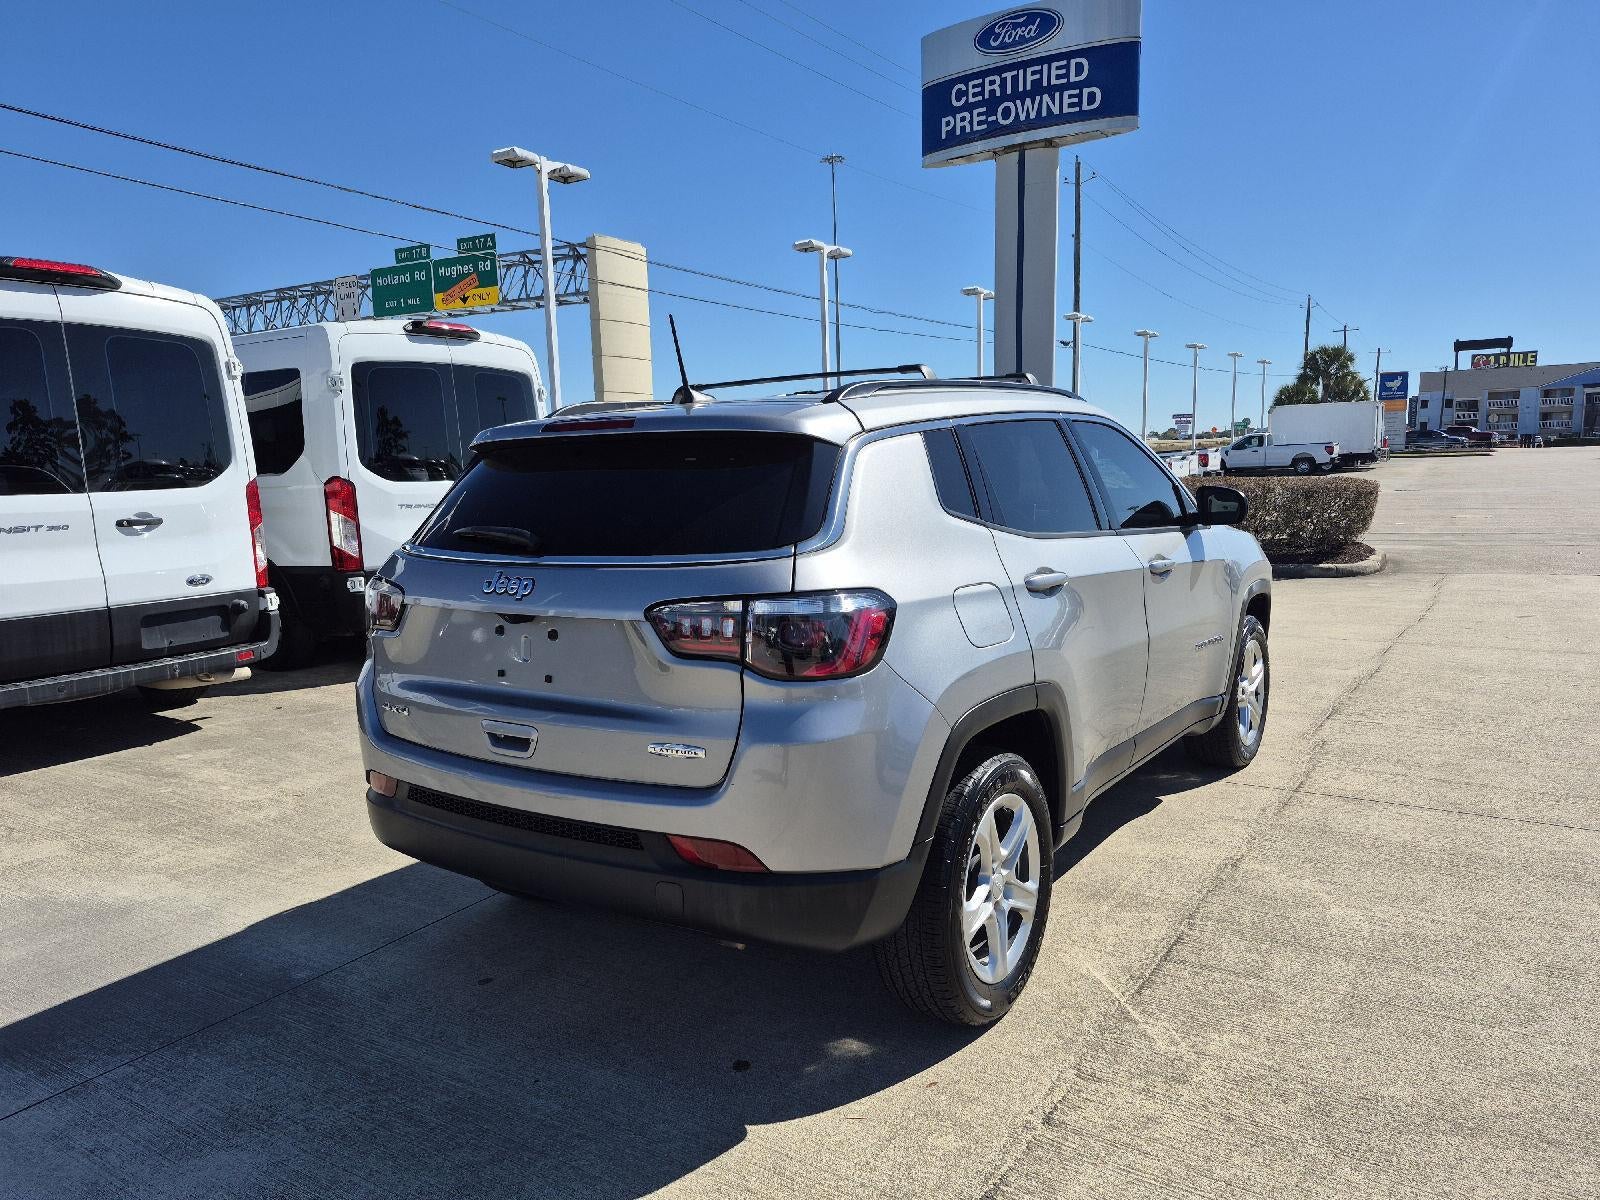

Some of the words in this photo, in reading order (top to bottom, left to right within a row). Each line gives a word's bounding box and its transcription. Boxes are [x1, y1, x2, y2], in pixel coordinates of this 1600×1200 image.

[990, 16, 1041, 47] Ford
[950, 57, 1089, 107] CERTIFIED
[941, 87, 1101, 139] PRE-OWNED
[460, 241, 474, 251] EXIT
[438, 263, 474, 278] Hughes
[478, 259, 491, 272] Rd
[336, 280, 357, 290] SPEED
[376, 271, 410, 288] Holland
[414, 269, 426, 282] Rd
[339, 291, 355, 301] LIMIT
[385, 300, 397, 308] EXIT
[400, 298, 405, 307] 1
[407, 297, 421, 306] MILE
[471, 291, 491, 302] ONLY
[482, 569, 535, 600] Jeep
[652, 747, 699, 756] LATITUDE
